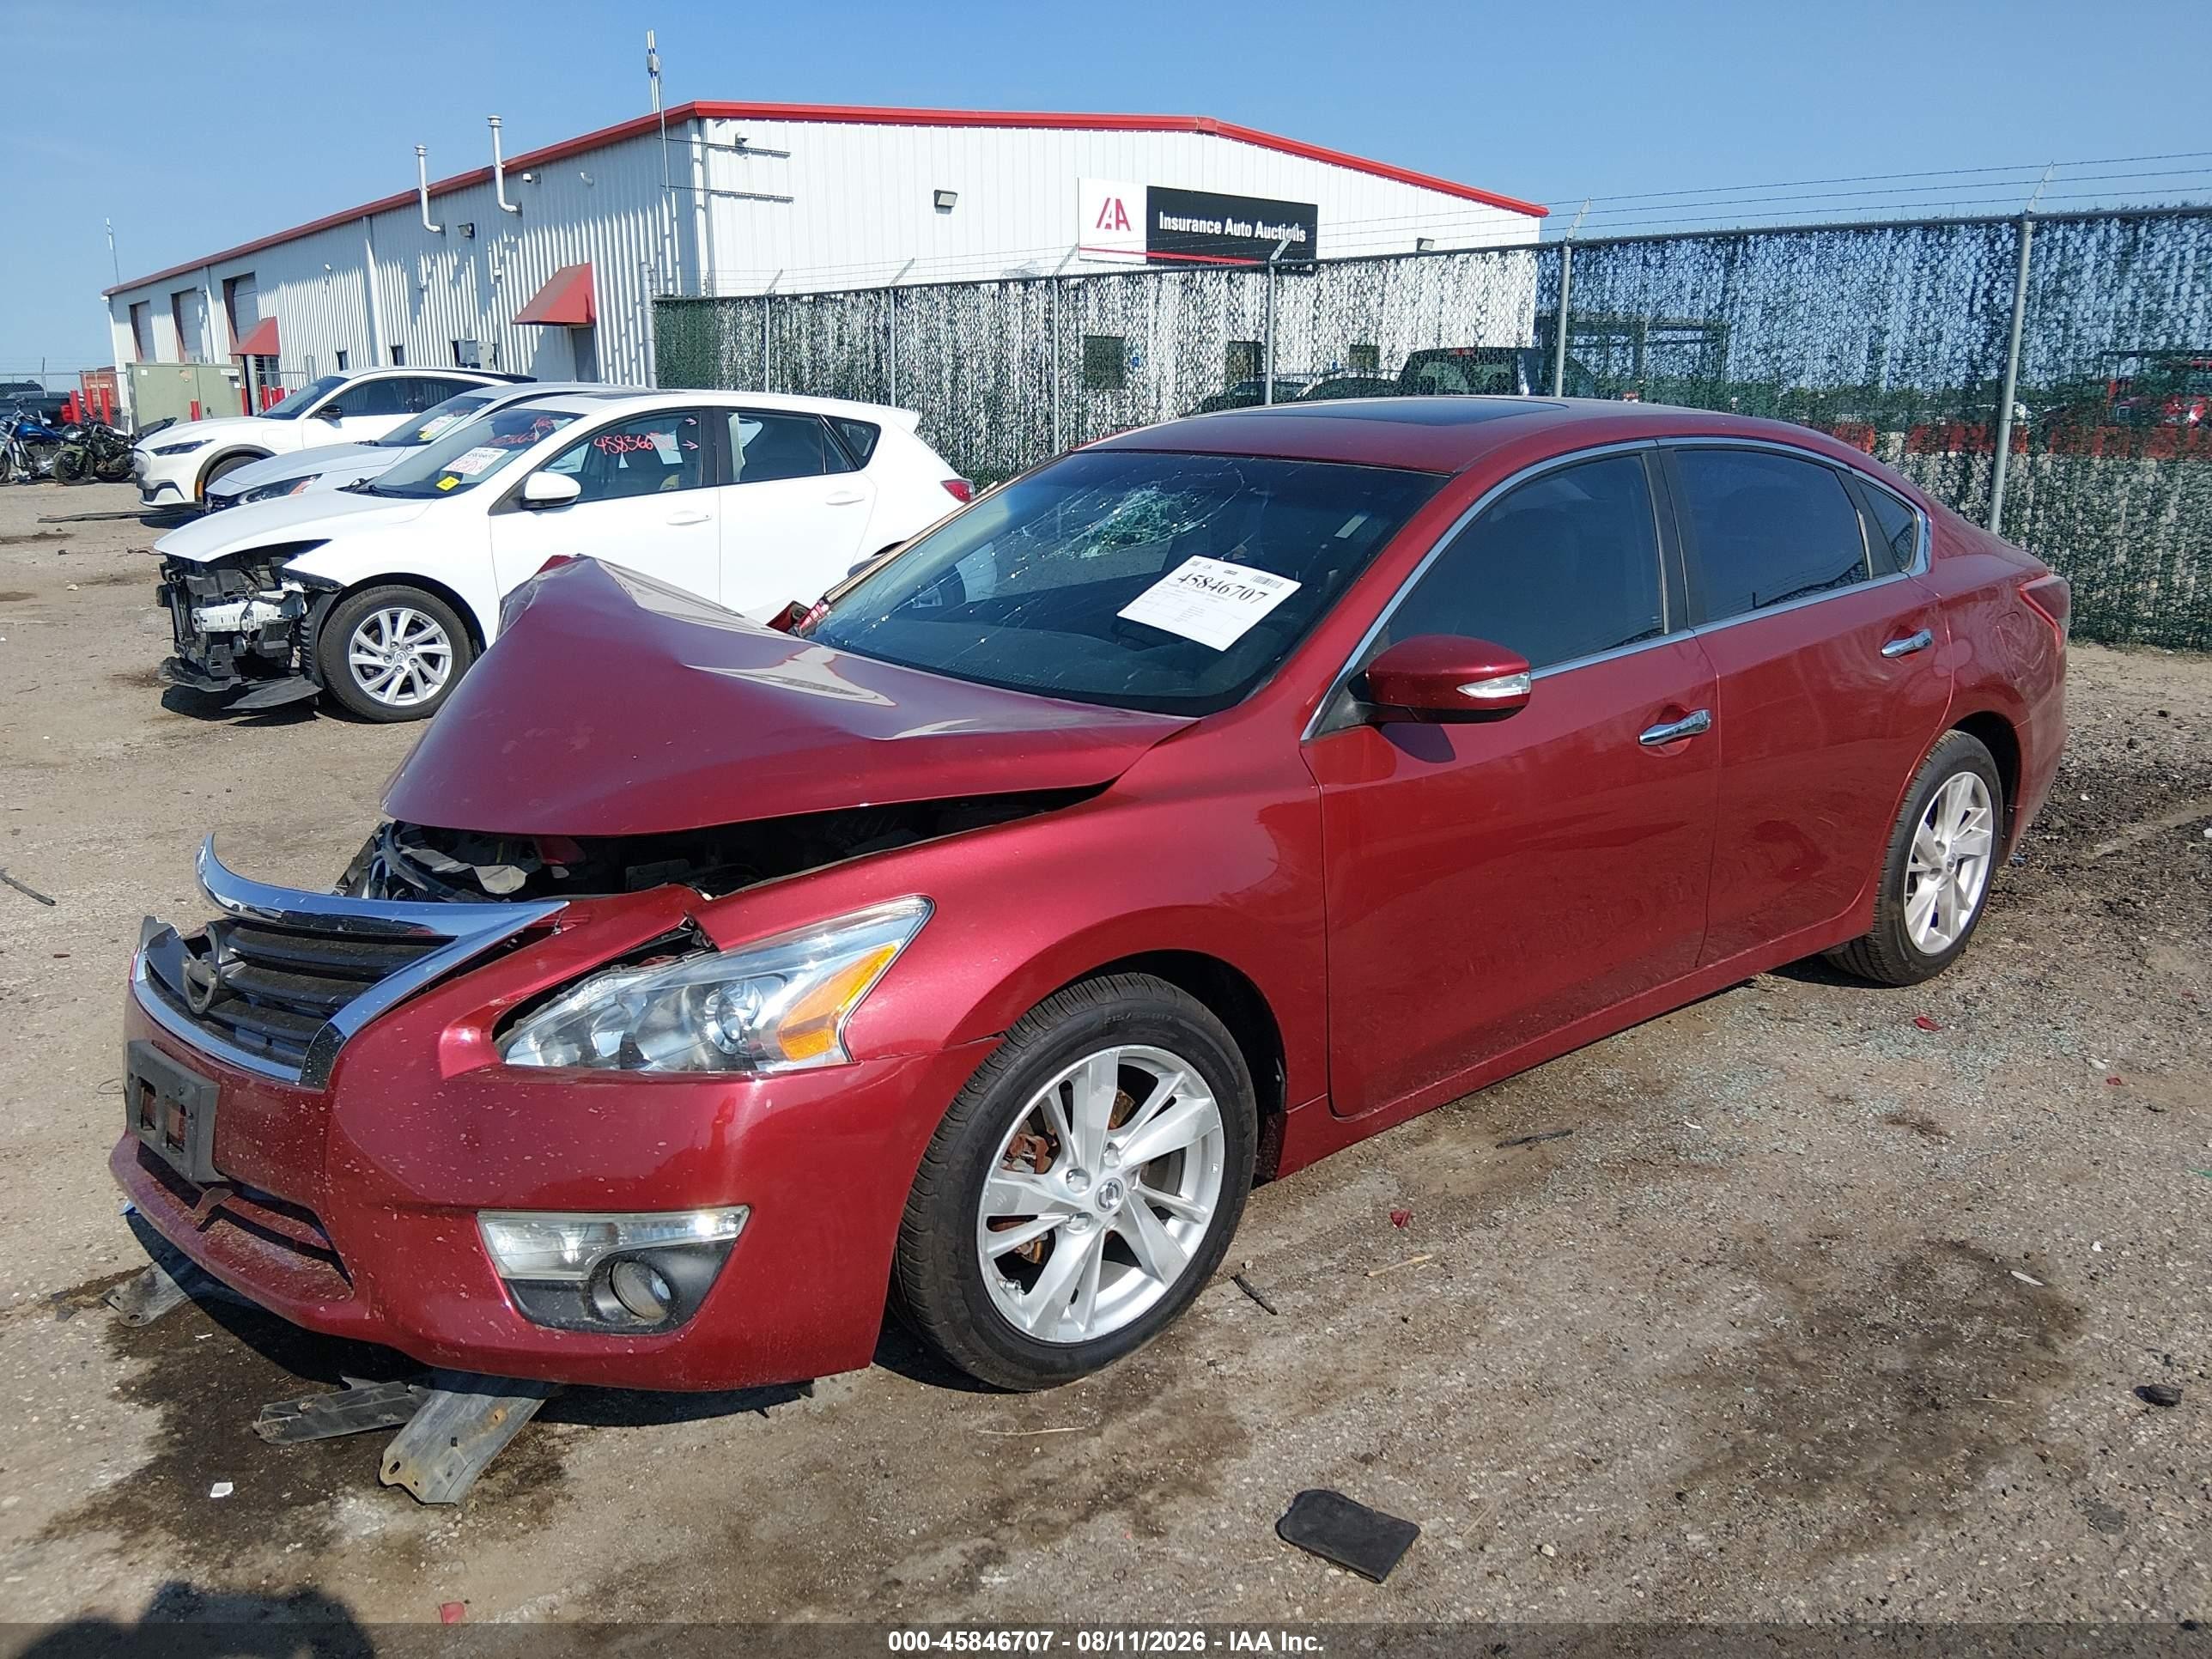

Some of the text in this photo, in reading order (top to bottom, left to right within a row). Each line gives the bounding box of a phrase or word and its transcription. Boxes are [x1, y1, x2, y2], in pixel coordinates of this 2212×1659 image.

[1159, 211, 1222, 235] Insurance
[1224, 217, 1252, 238] Auto
[1176, 572, 1269, 605] 45846707
